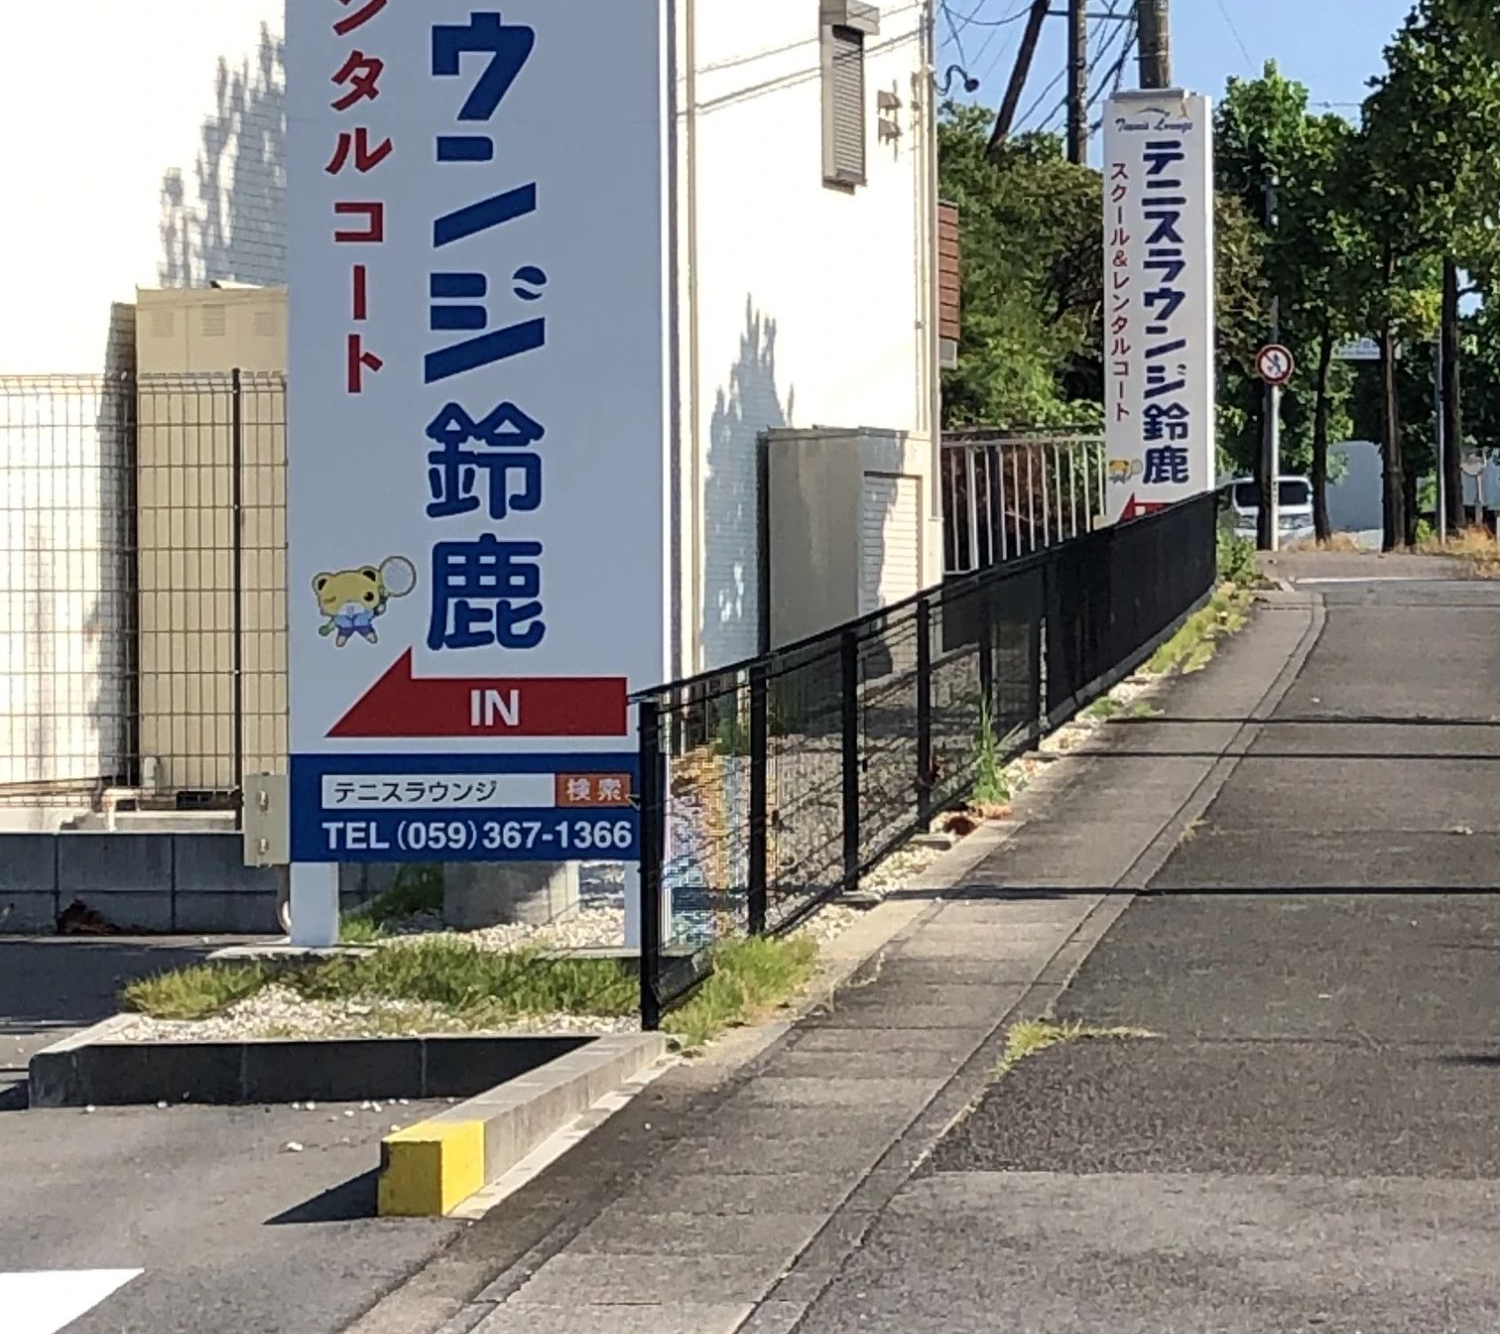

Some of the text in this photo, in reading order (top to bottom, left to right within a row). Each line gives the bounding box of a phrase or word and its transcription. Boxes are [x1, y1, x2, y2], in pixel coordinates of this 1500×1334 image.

[1111, 163, 1131, 422] スクール&レンタルコート
[1141, 140, 1190, 485] テニスラウンジ鈴鹿
[470, 689, 520, 726] IN
[333, 778, 622, 803] テニスラウンジ 検索
